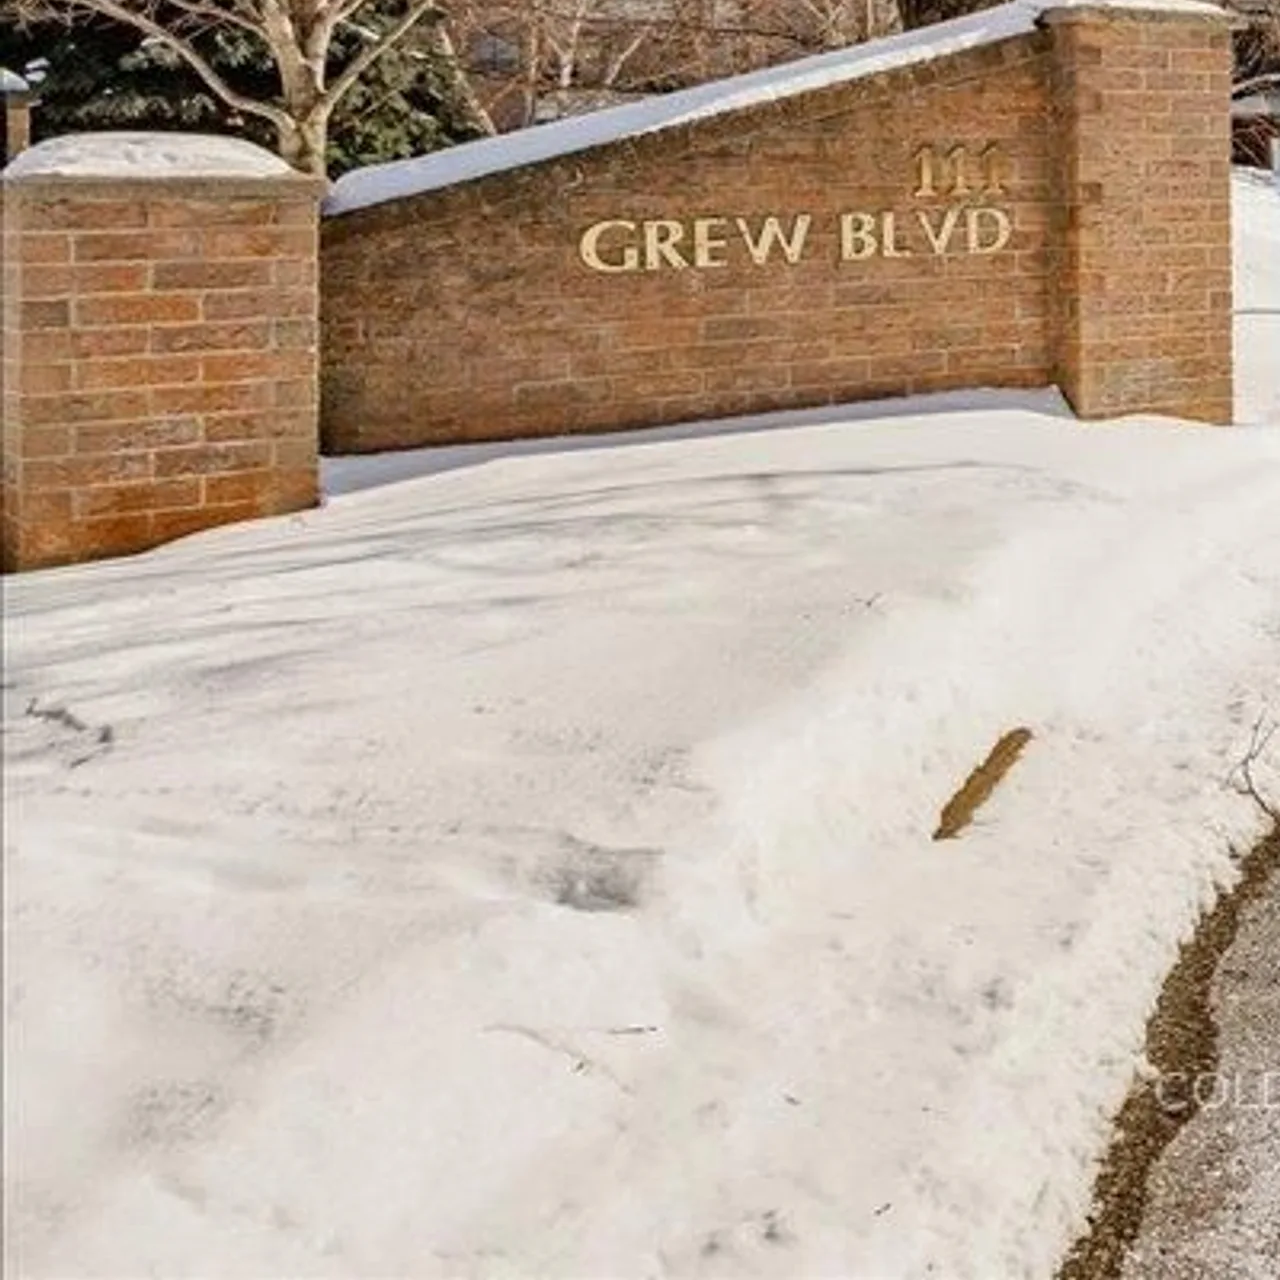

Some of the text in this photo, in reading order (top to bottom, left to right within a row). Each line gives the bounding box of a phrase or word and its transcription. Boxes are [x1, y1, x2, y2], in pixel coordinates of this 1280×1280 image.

[914, 144, 1007, 198] 111
[580, 207, 1012, 274] GREW BLVD
